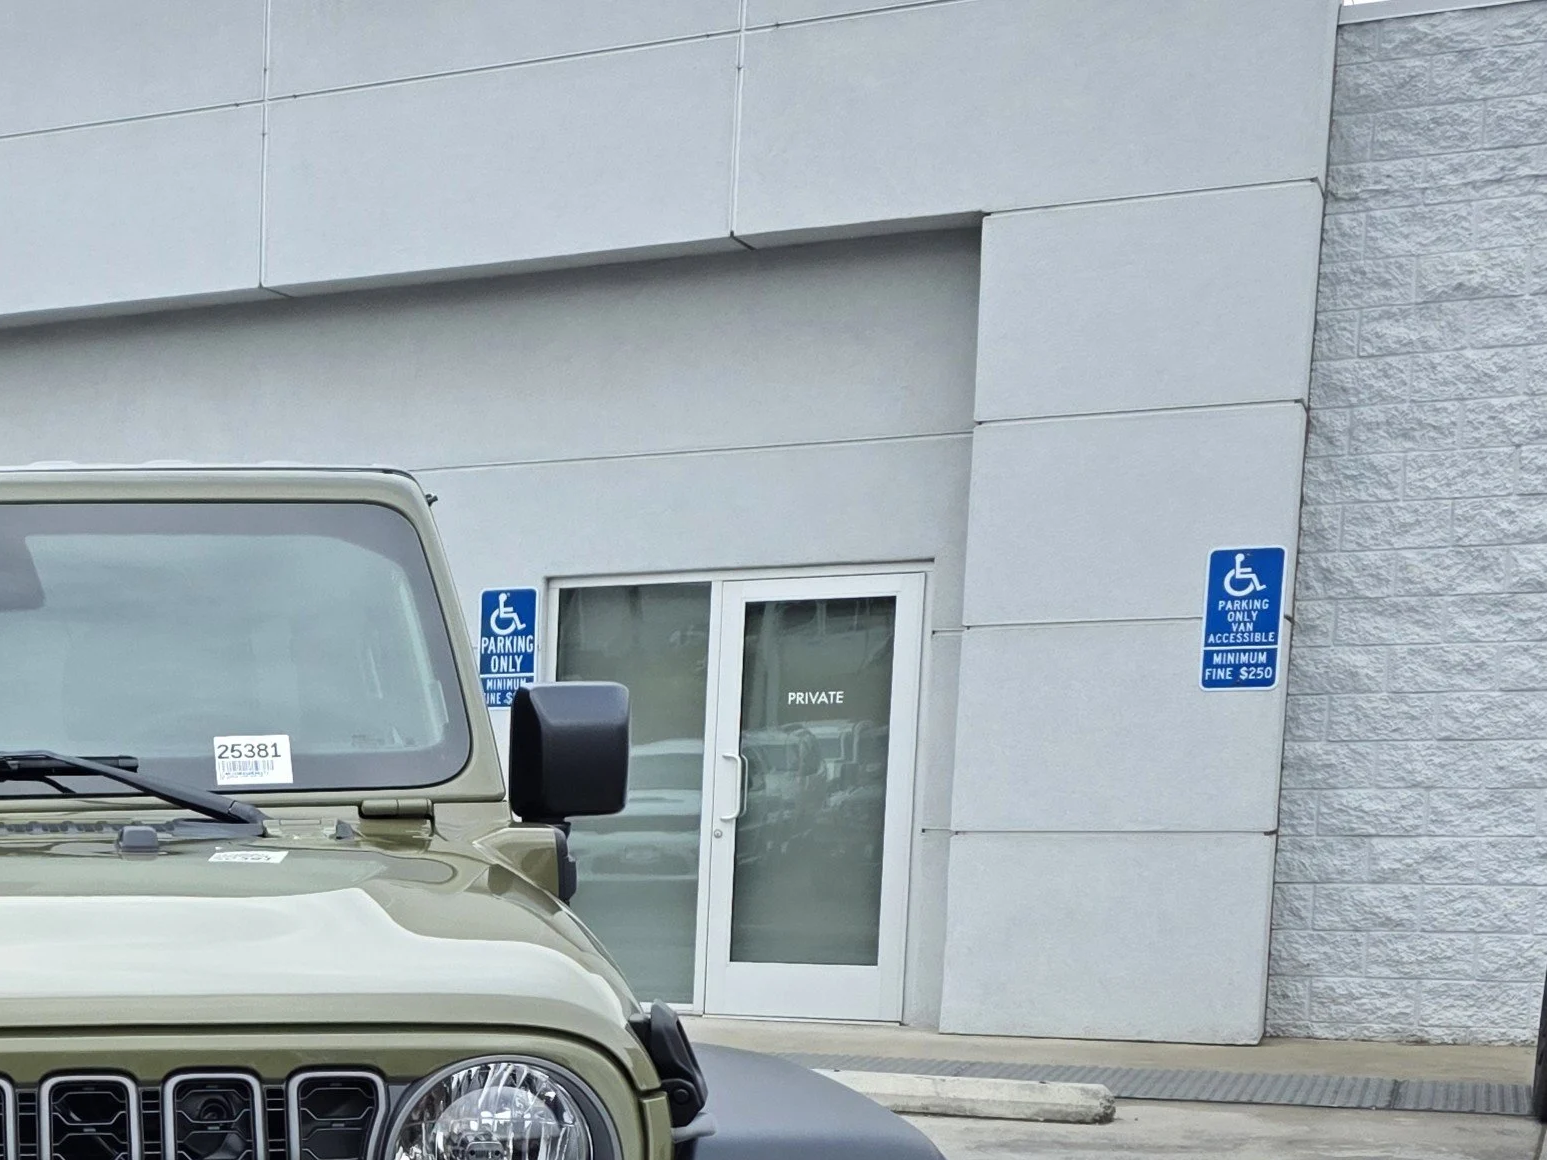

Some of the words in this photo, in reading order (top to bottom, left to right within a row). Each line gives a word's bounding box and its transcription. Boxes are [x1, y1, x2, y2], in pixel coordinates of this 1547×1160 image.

[1218, 599, 1270, 611] PARKING
[1227, 611, 1259, 622] ONLY
[1232, 622, 1254, 632] VAN
[481, 635, 534, 654] PARKING
[1207, 632, 1276, 644] ACCESSIBLE
[490, 655, 524, 673] ONLY
[1212, 651, 1267, 665] MINIMUM
[1204, 667, 1234, 681] FINE
[1239, 666, 1273, 680] $250
[787, 691, 845, 705] PRIVATE
[217, 742, 282, 759] 25381
